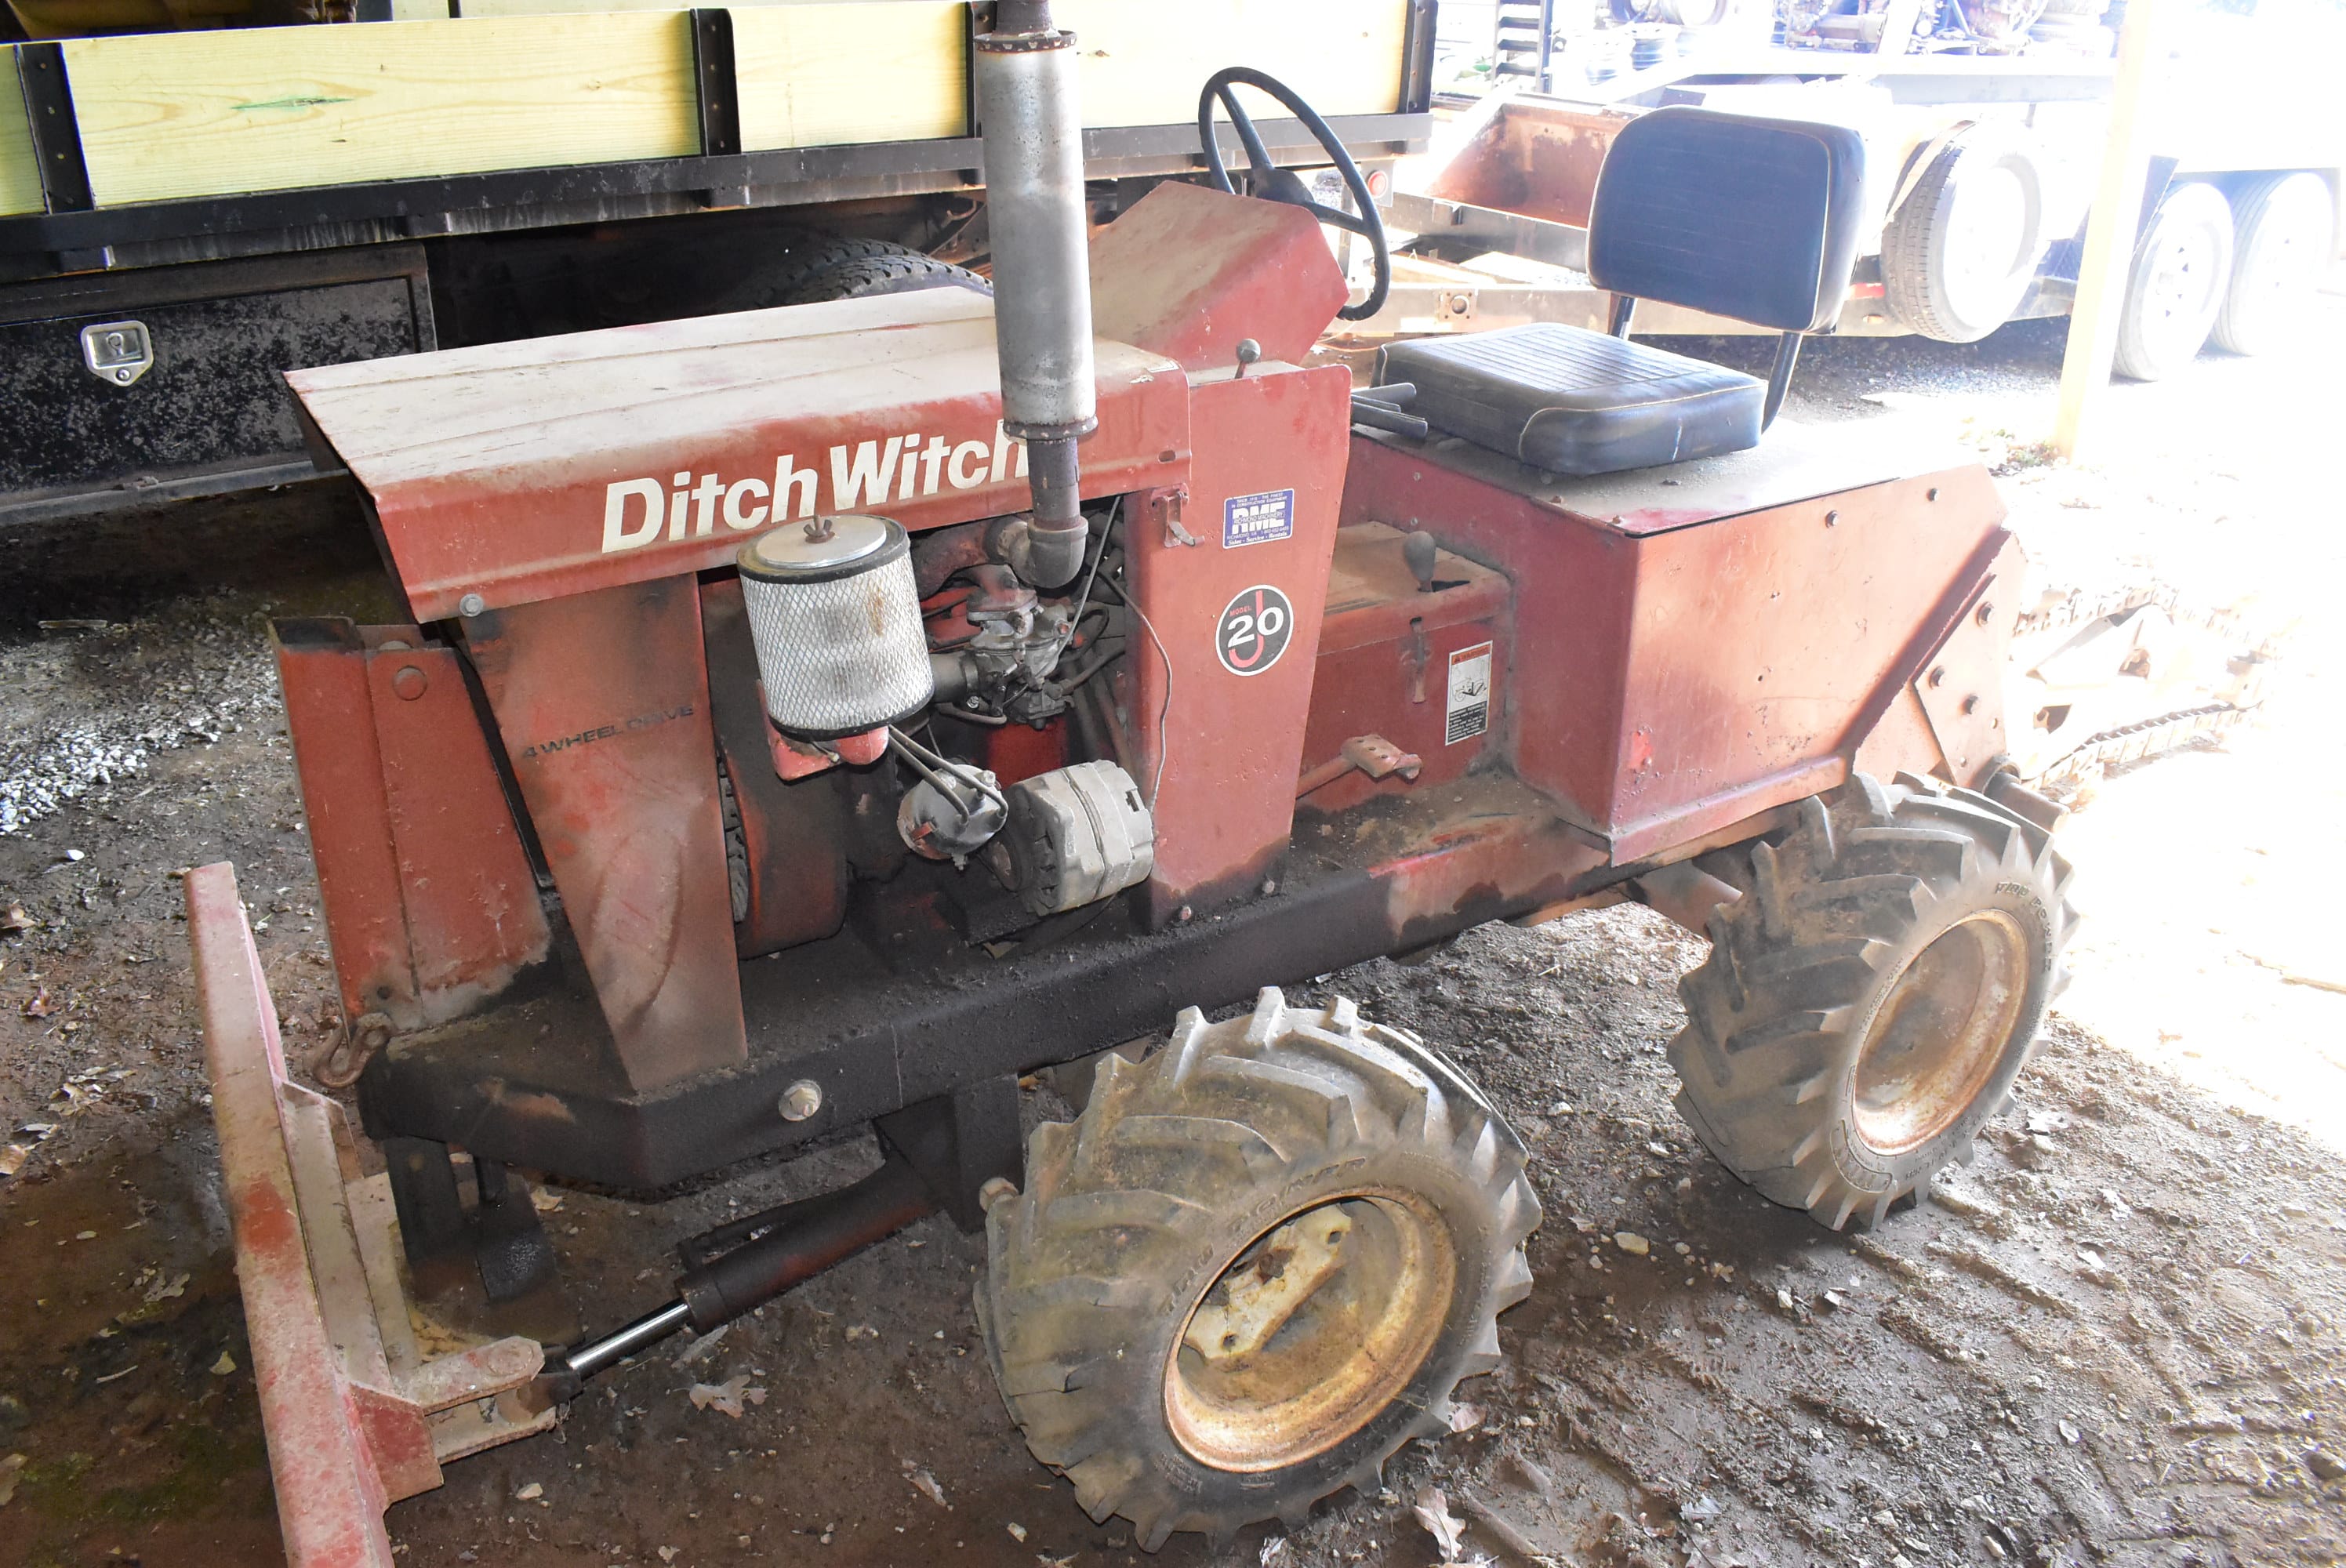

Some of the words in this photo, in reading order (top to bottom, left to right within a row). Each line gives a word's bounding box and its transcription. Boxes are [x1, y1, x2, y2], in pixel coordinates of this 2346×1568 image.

[601, 453, 819, 554] Ditch
[829, 419, 1028, 512] Witch
[1232, 501, 1286, 535] RME
[1233, 514, 1257, 524] RICHMOND
[1258, 511, 1284, 521] MACHINERY
[1246, 534, 1265, 543] Service
[1227, 607, 1284, 648] 20
[1229, 605, 1252, 617] MODEL
[523, 746, 538, 758] 4
[539, 724, 624, 753] WHEEL
